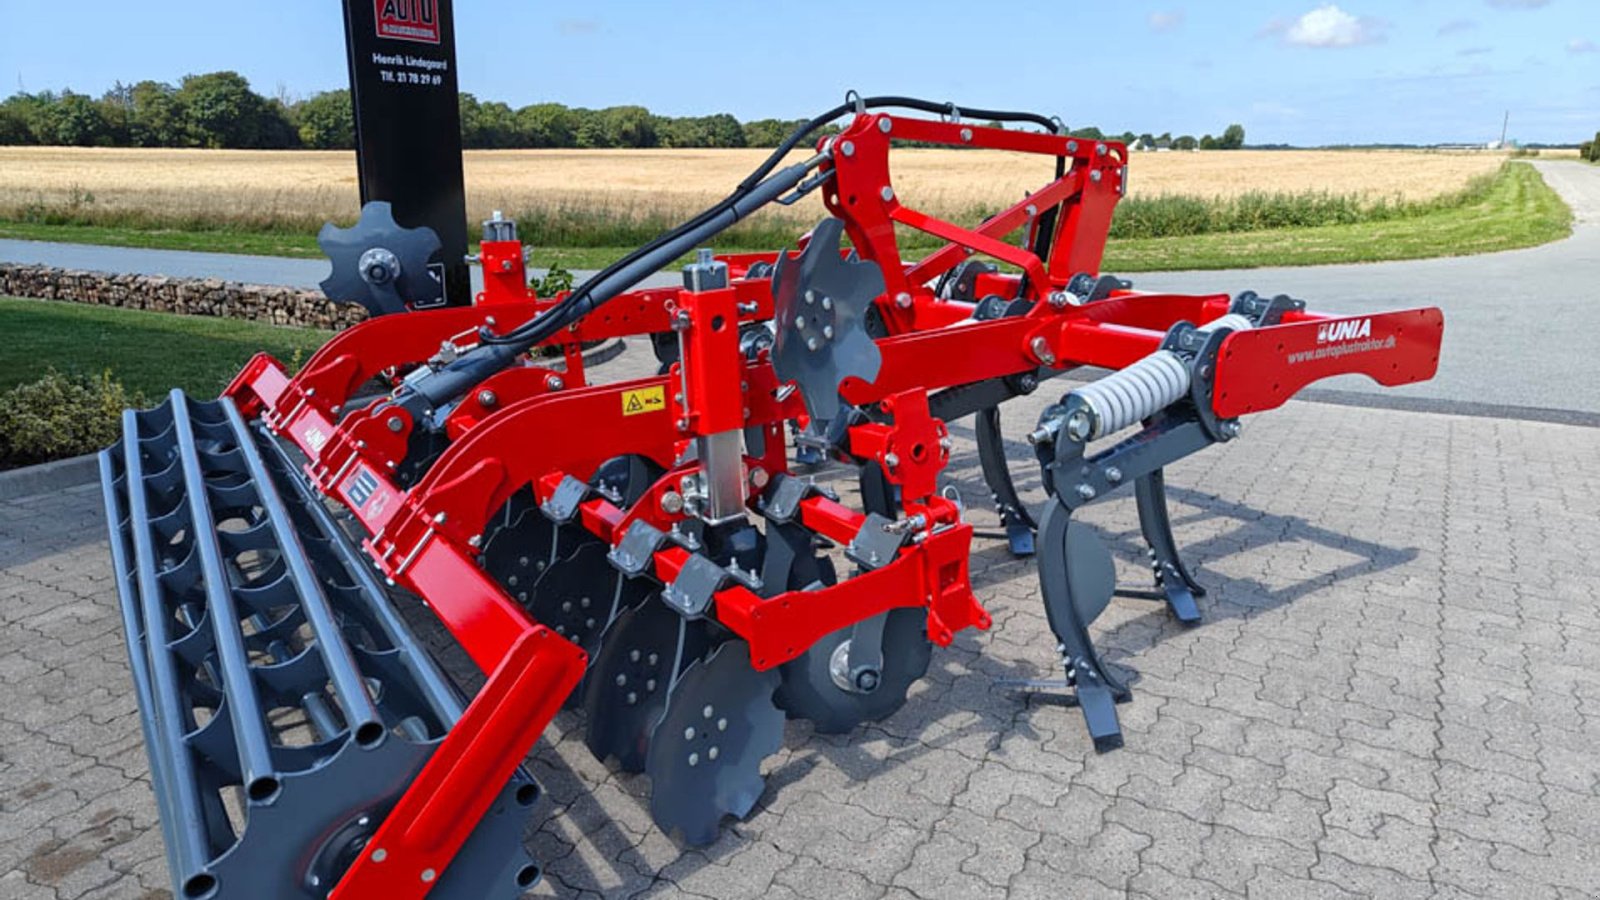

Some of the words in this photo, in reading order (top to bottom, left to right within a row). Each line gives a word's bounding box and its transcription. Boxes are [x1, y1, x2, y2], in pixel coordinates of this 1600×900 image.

[372, 52, 403, 65] Henrik
[405, 55, 447, 71] Lindegaard
[1328, 318, 1371, 341] UNIA
